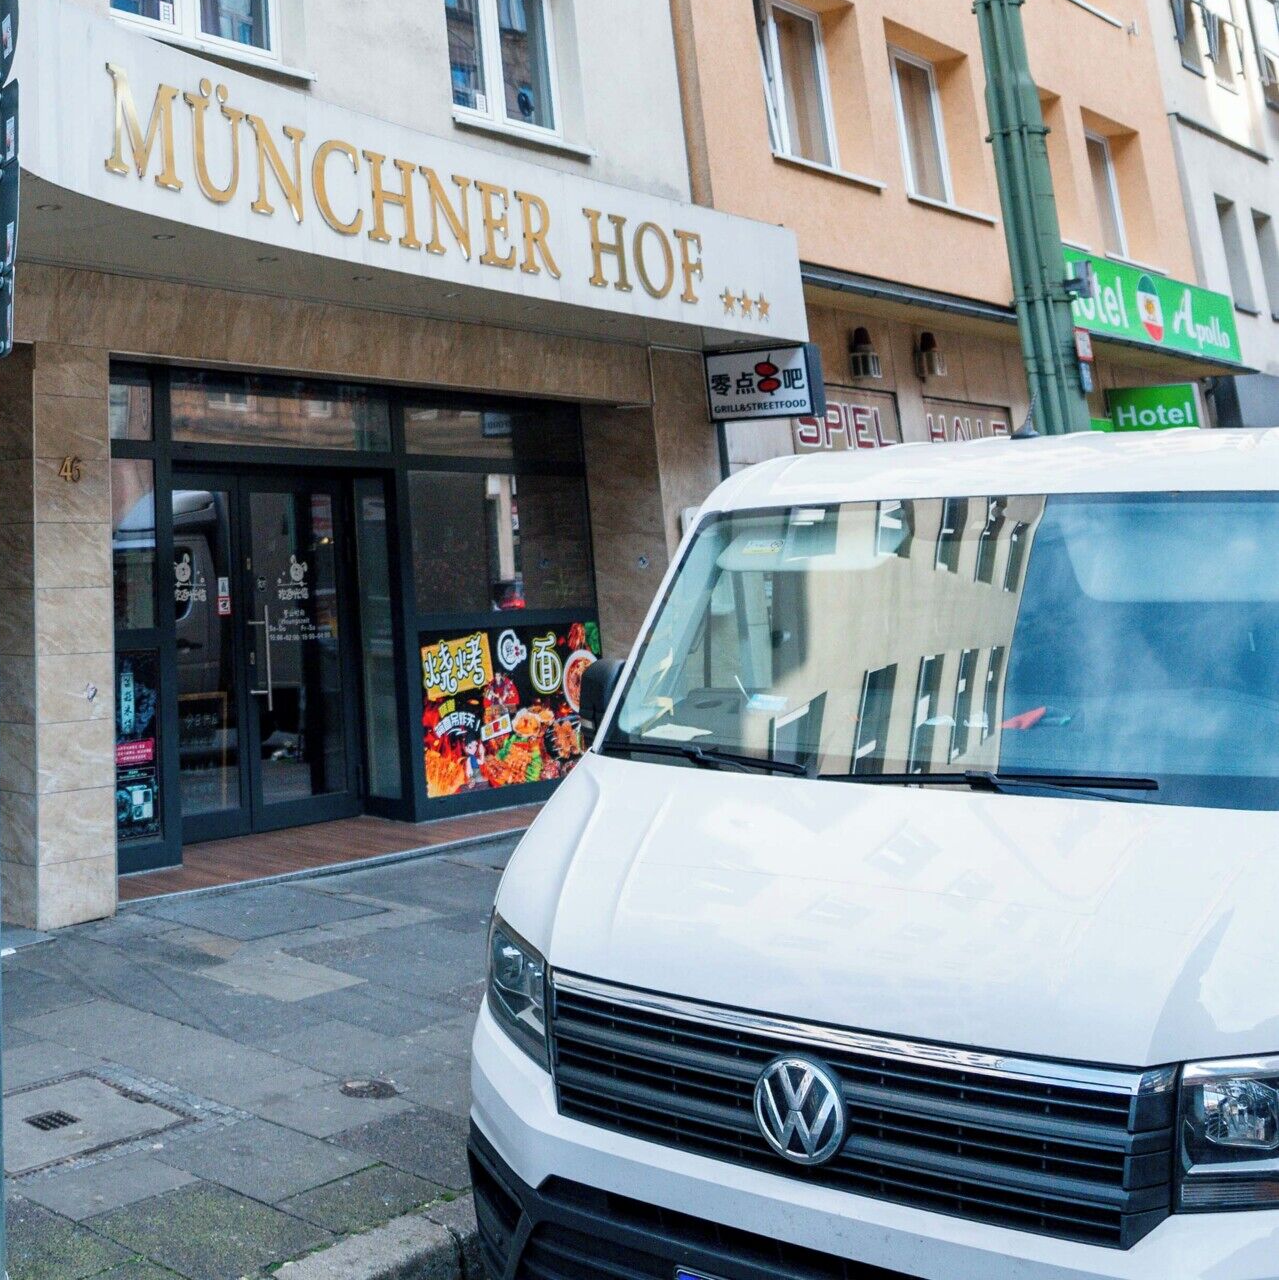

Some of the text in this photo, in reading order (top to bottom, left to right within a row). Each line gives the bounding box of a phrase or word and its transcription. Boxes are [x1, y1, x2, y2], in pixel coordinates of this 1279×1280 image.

[104, 62, 704, 303] MÜNCHNER HOF
[1173, 288, 1230, 349] Apollo
[714, 399, 807, 414] GRILL&STREETFOOD
[798, 400, 897, 449] SPIEL
[1116, 401, 1194, 427] Hotel
[58, 456, 81, 482] 46
[424, 632, 485, 694] 烧烤
[531, 631, 562, 694] 面
